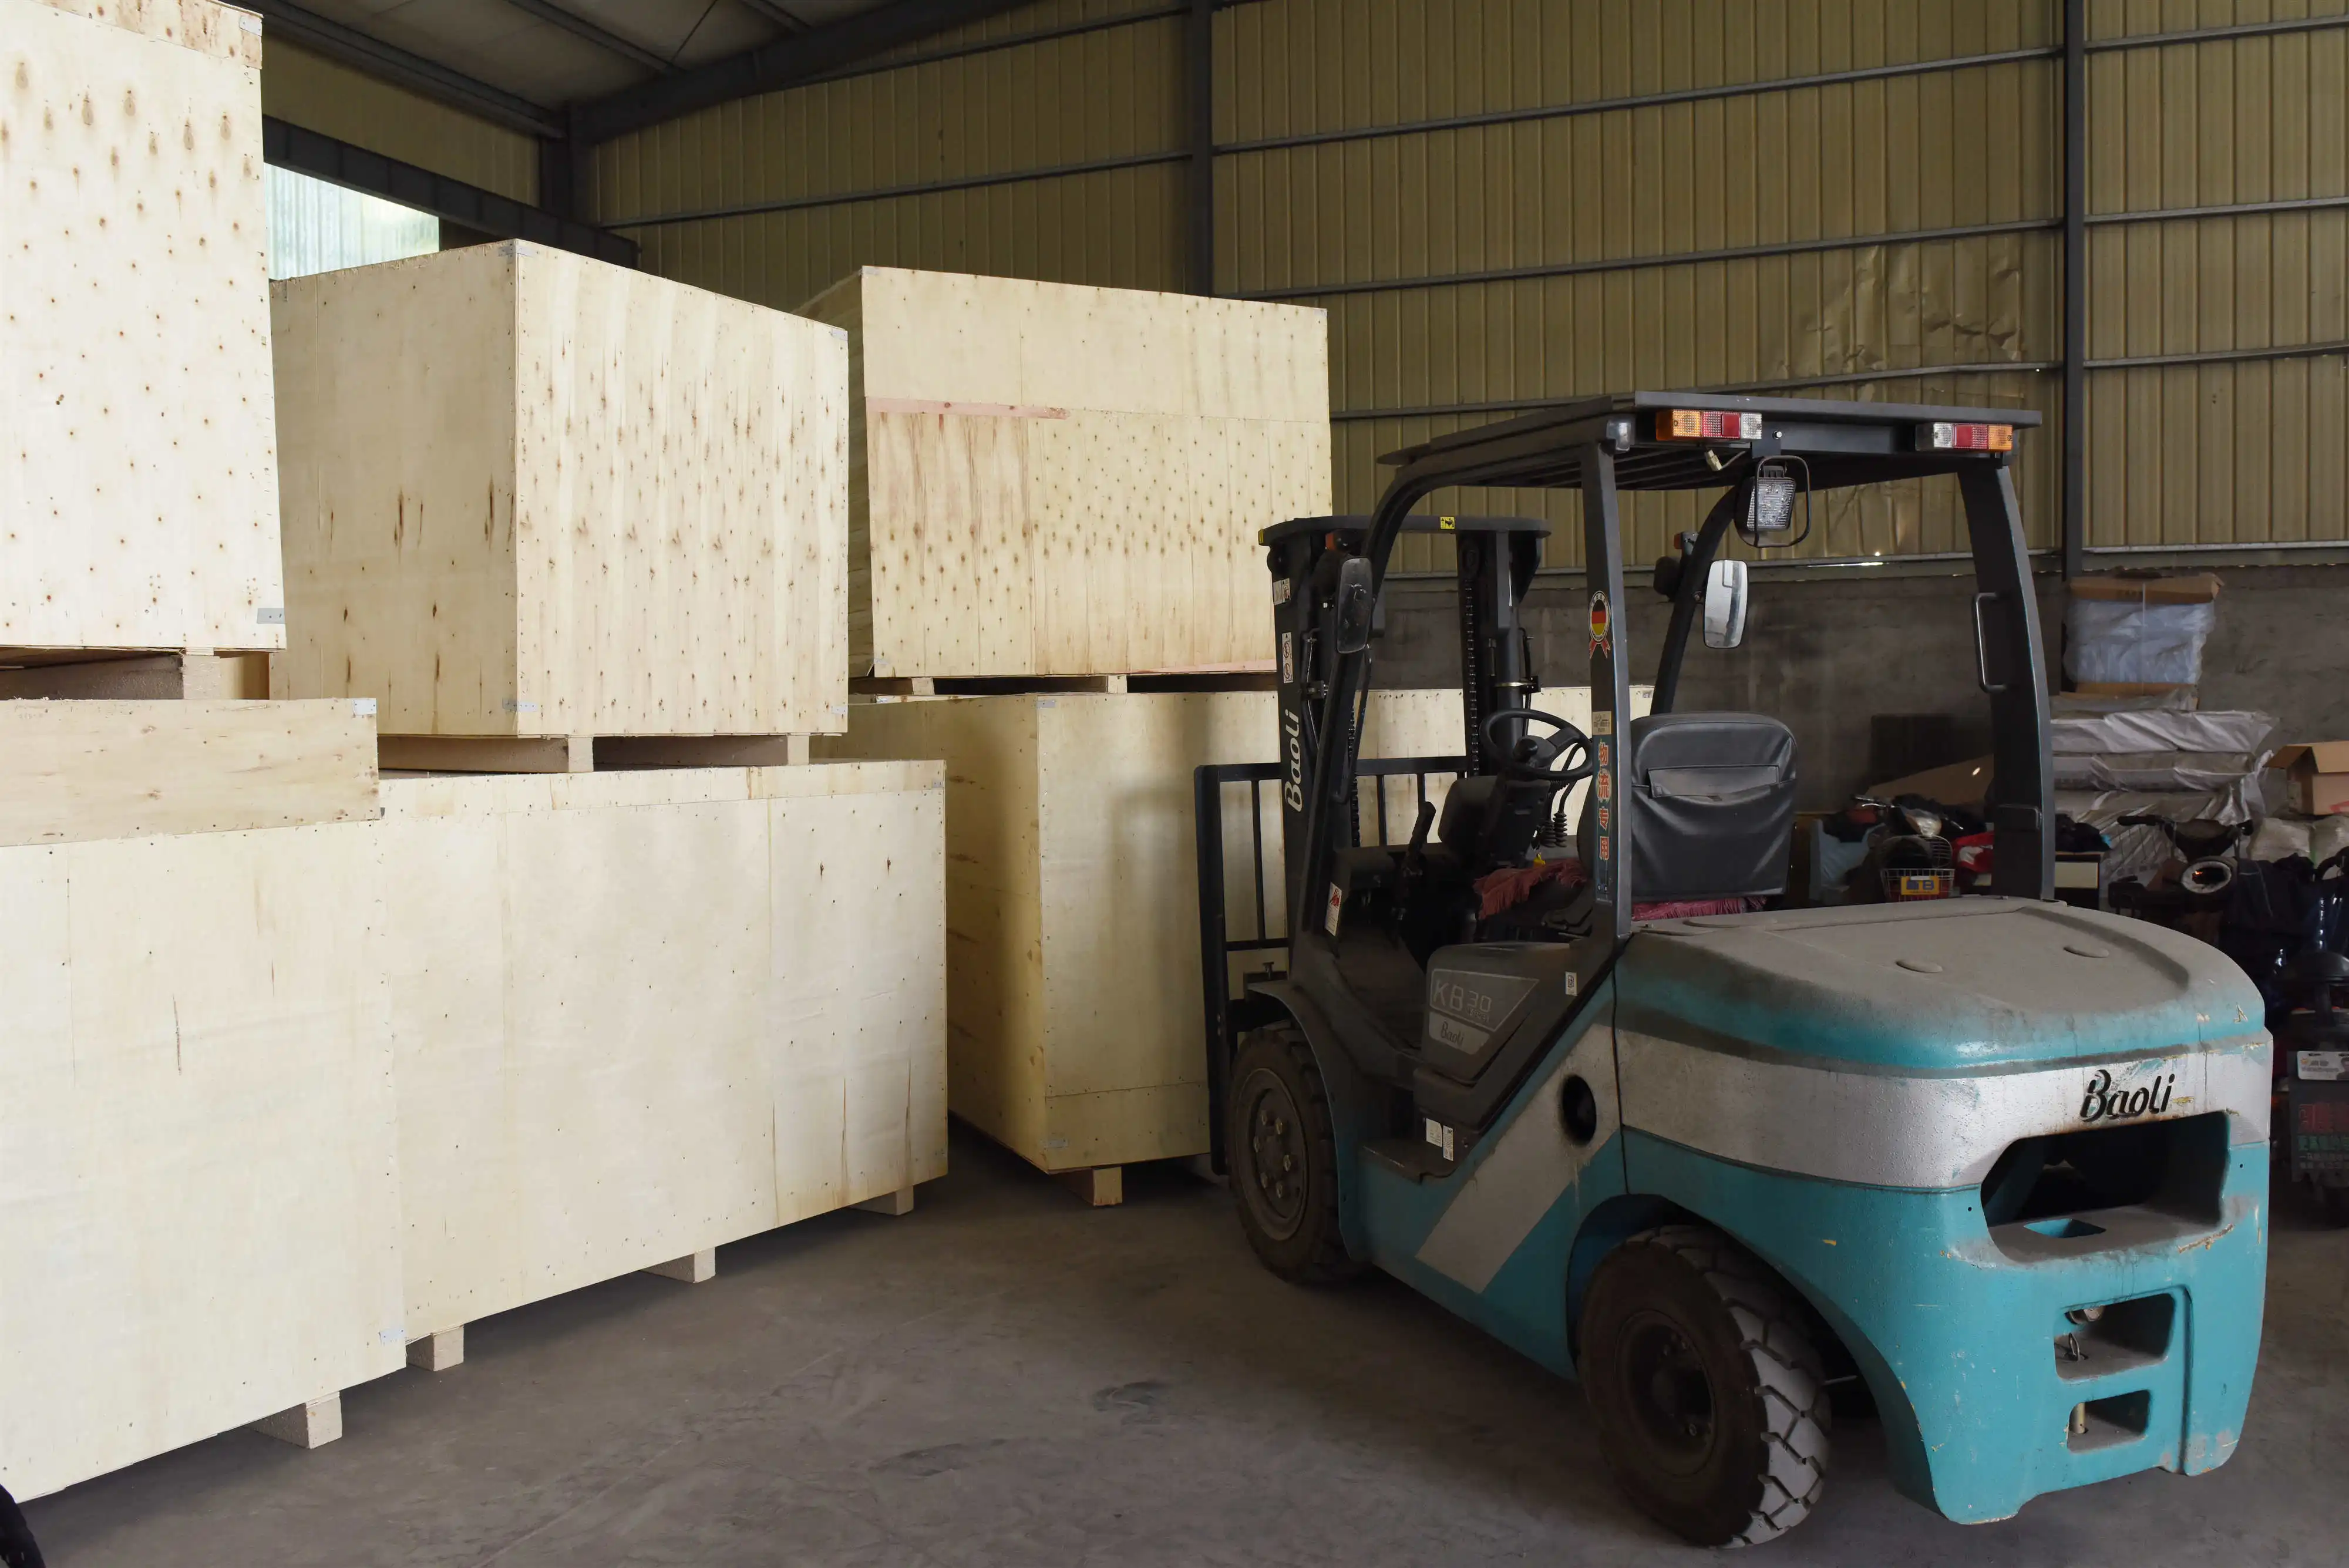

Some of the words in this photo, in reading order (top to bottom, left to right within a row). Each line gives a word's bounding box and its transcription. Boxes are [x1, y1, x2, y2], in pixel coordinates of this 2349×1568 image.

[1284, 709, 1303, 812] Baoli
[1598, 742, 1610, 860] 物流专用
[1441, 1019, 1465, 1045] Baoli
[2079, 1069, 2175, 1122] Baoli
